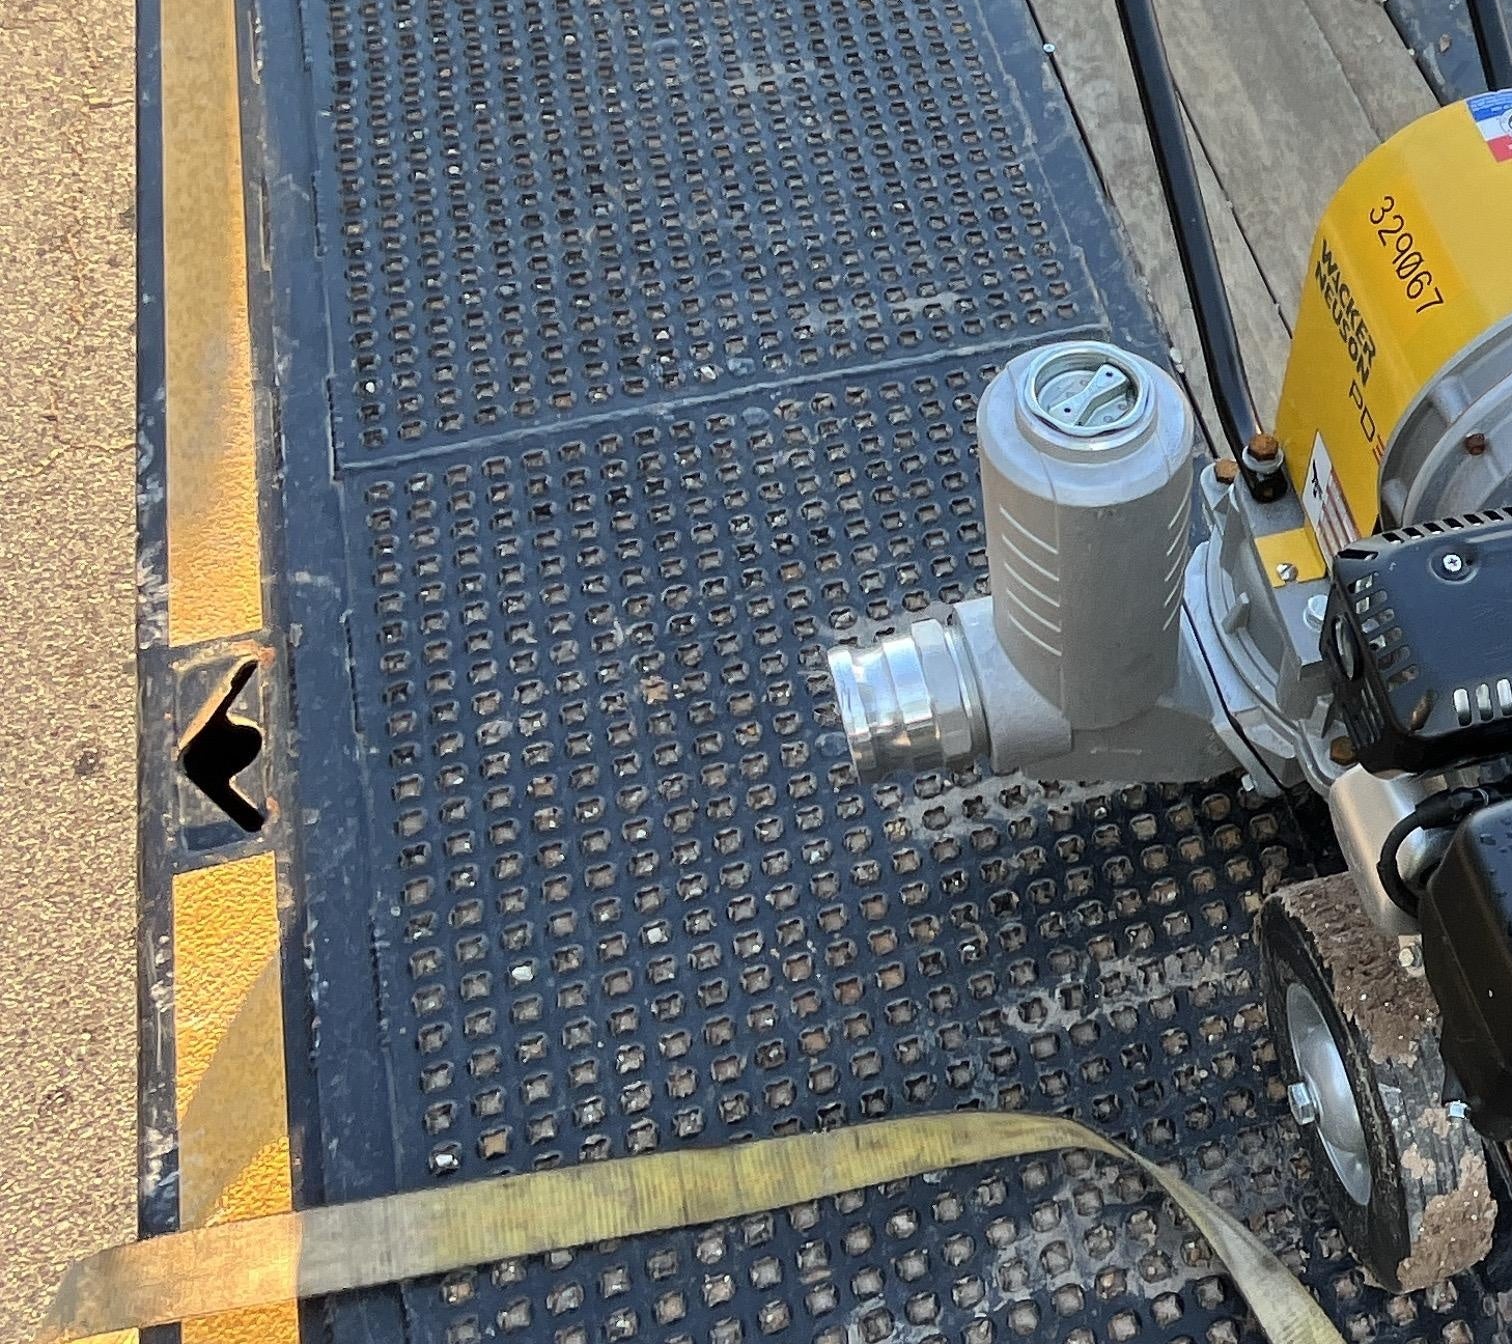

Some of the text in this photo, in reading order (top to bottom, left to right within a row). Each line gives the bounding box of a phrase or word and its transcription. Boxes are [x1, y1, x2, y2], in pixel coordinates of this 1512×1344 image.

[1322, 238, 1376, 368] WACKER
[1369, 195, 1444, 314] 329067
[1315, 259, 1370, 386] NEUSON
